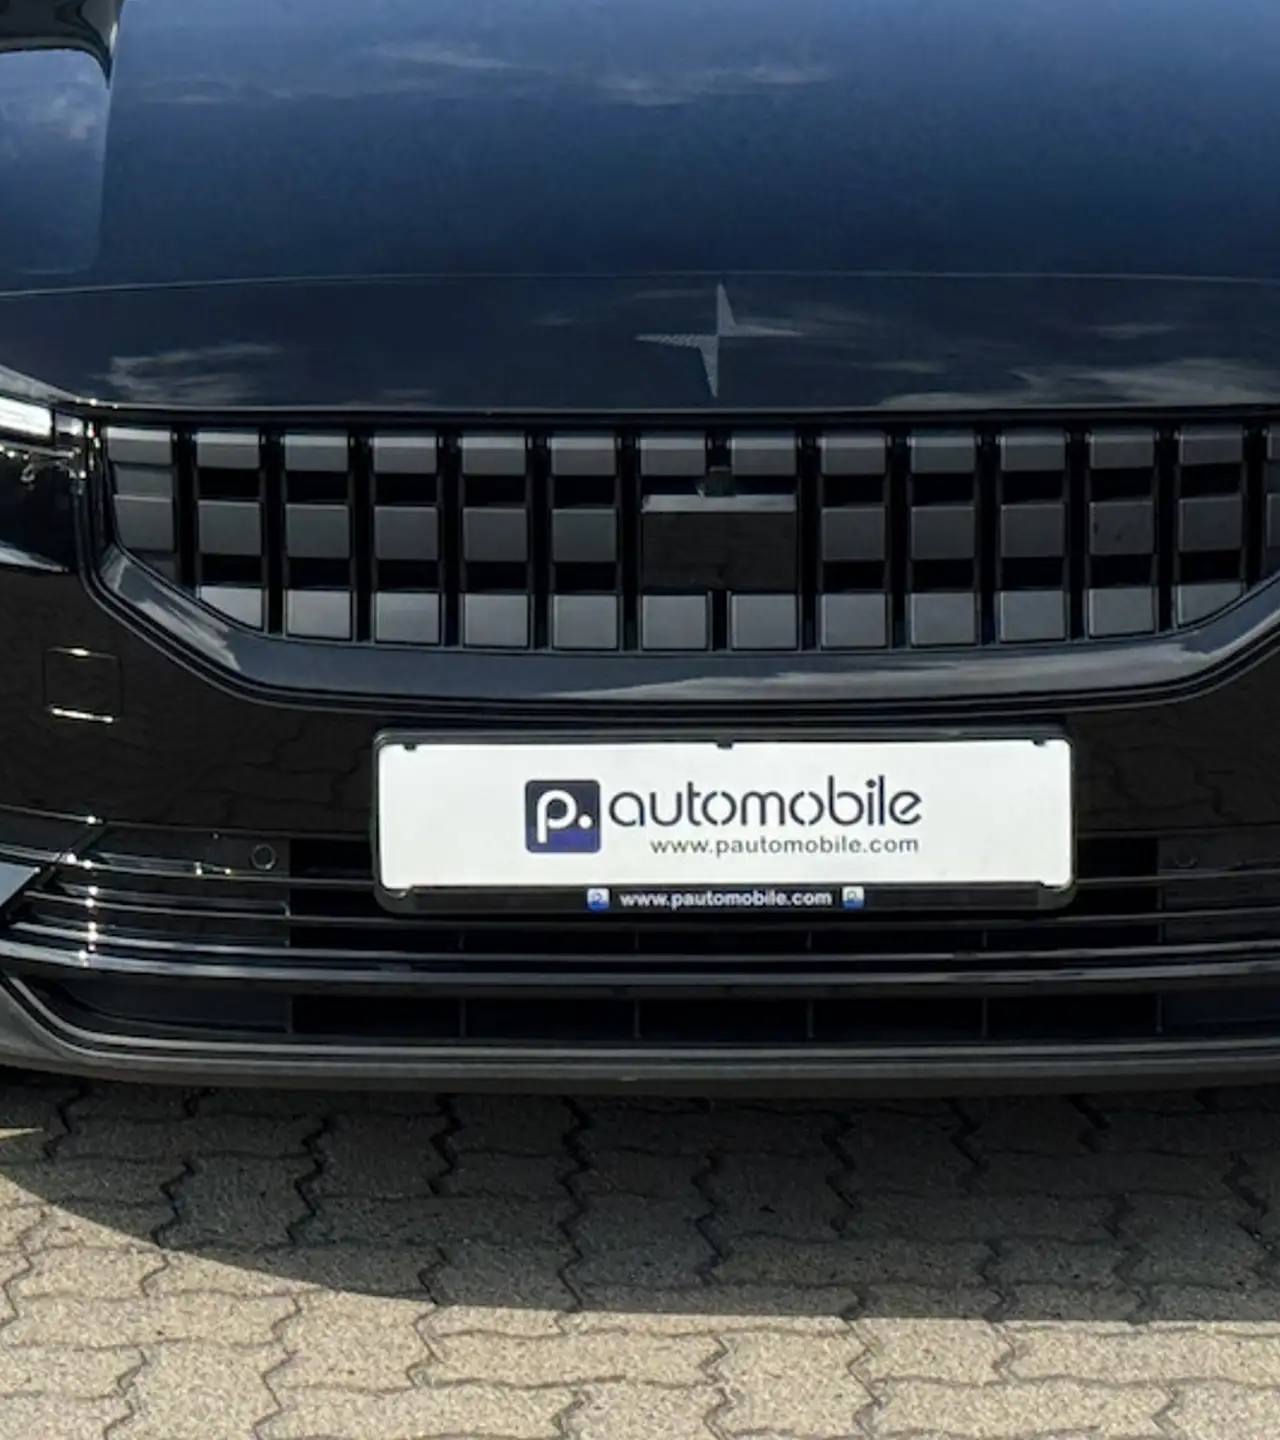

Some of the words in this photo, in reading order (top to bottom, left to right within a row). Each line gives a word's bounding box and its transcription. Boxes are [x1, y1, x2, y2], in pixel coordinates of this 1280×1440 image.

[608, 775, 922, 827] automobile
[650, 835, 919, 858] www.pautomobile.com
[620, 889, 832, 909] www.pautomobile.com
